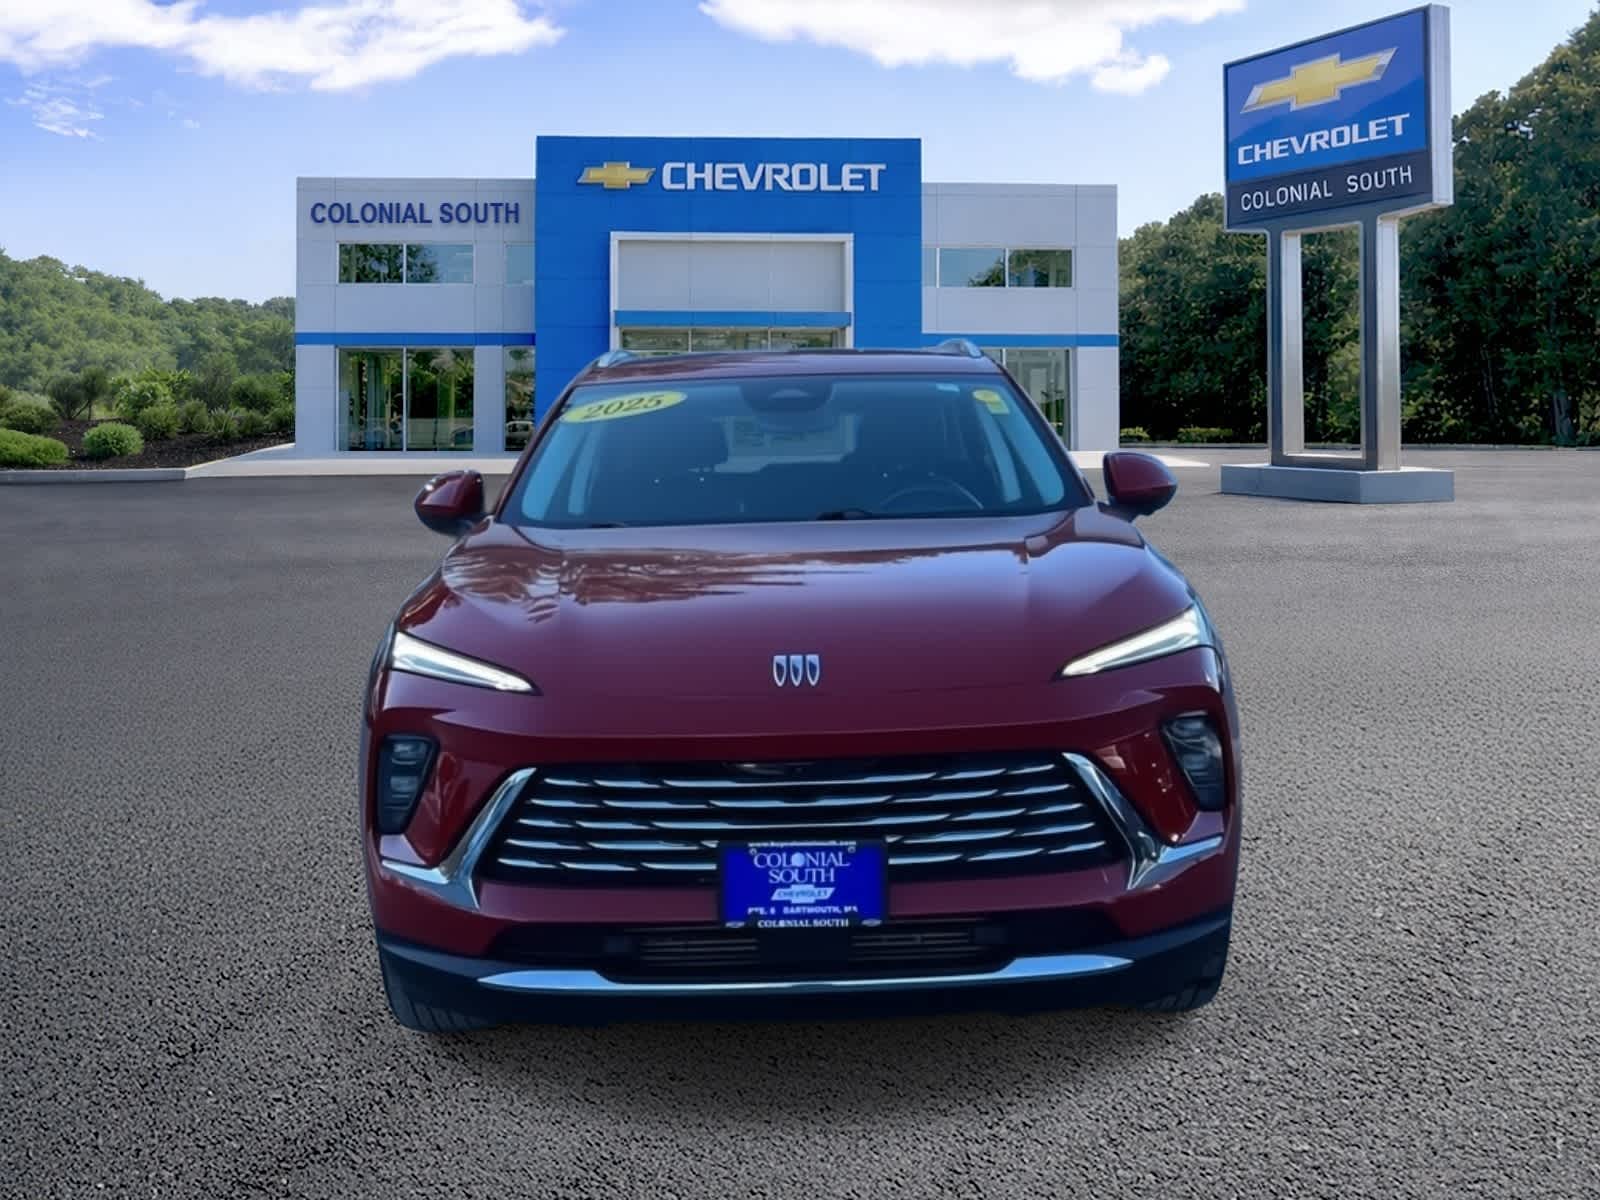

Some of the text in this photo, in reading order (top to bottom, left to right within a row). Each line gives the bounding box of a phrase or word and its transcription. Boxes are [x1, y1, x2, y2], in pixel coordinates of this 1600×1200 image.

[1238, 113, 1410, 165] CHEVROLET
[661, 161, 888, 193] CHEVROLET
[1241, 165, 1412, 211] COLONIAL SOUTH
[310, 202, 520, 225] COLONIAL SOUTH
[583, 394, 665, 418] 2025
[753, 852, 850, 868] COLONIAL
[768, 868, 835, 883] SOUTH
[757, 918, 849, 928] COLONIAL SOUTH
